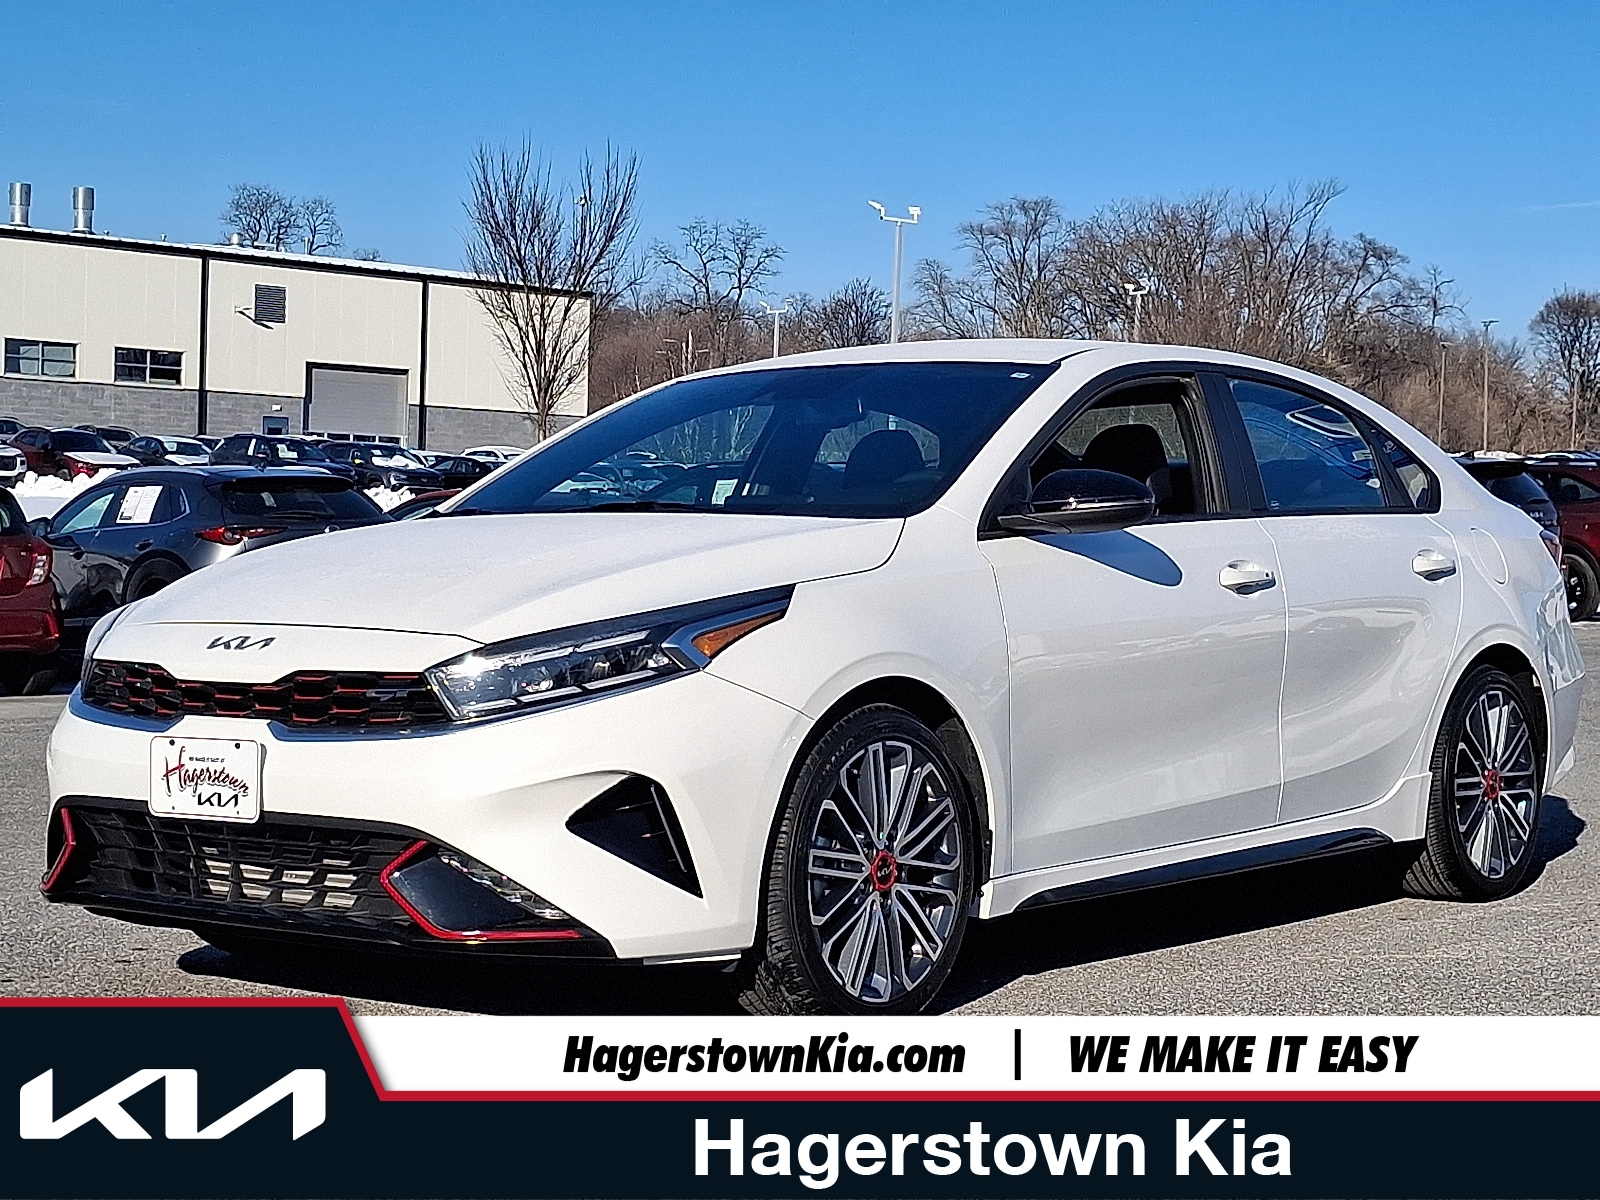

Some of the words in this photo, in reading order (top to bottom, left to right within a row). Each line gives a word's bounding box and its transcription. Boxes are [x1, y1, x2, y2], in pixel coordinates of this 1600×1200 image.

[206, 635, 276, 650] KIA
[161, 745, 249, 797] Hagerstown
[197, 791, 239, 808] KIA
